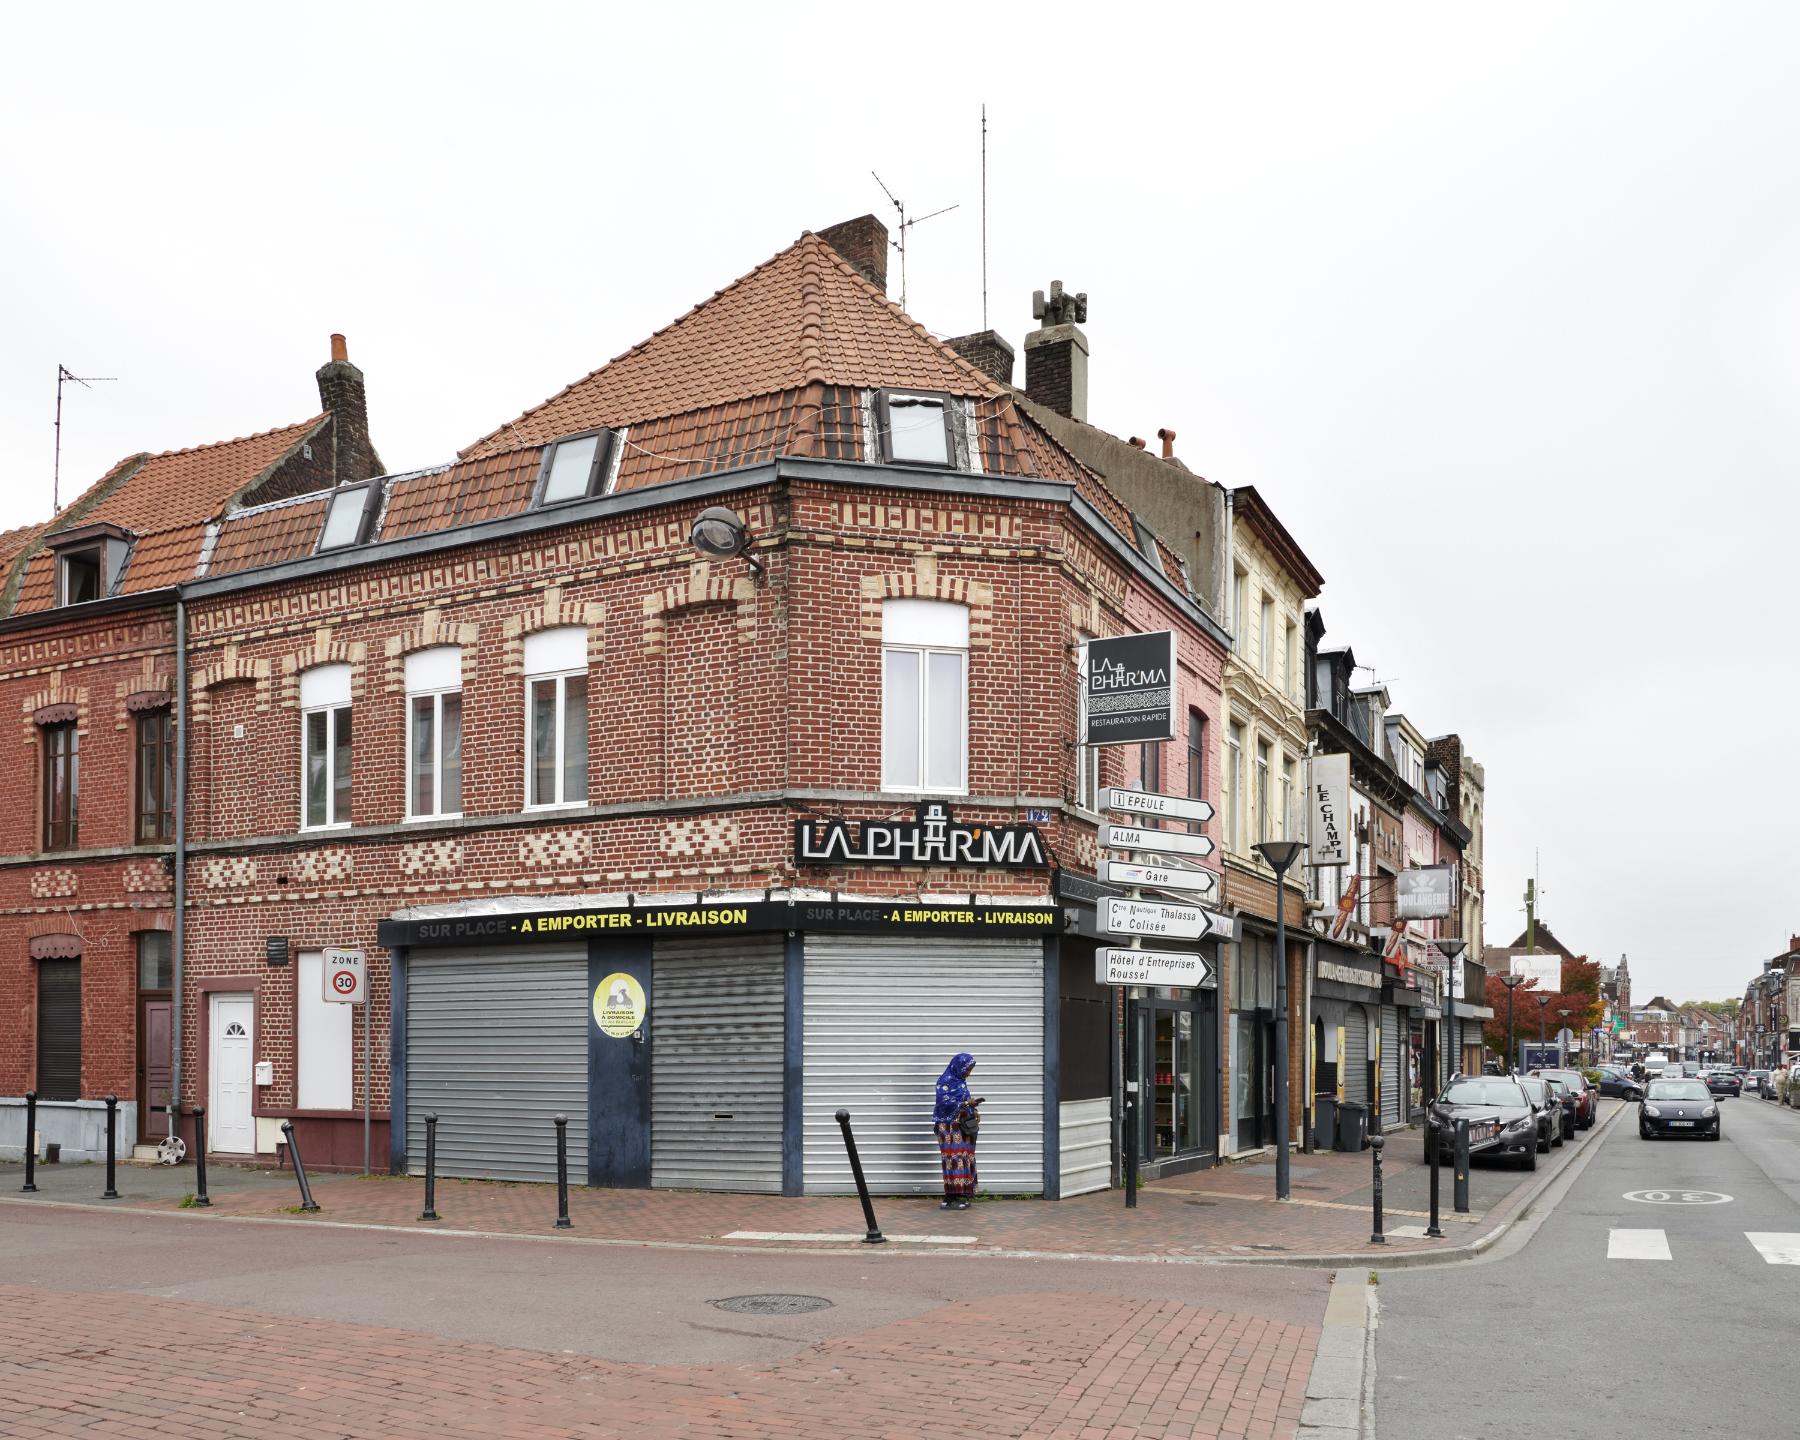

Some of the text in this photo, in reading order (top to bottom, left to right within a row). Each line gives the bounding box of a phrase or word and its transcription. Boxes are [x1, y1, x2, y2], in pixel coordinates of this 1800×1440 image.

[1092, 657, 1112, 673] LA
[1091, 712, 1167, 727] RESTAURATION RAPIDE
[1316, 784, 1329, 801] LE
[1128, 796, 1165, 811] EPEULE
[802, 823, 850, 859] LA
[1112, 831, 1141, 844] ALMA
[1145, 870, 1169, 883] Gare
[806, 908, 834, 920] SUR
[838, 908, 880, 921] PLACE
[891, 910, 901, 922] A
[904, 910, 974, 923] EMPORTER
[985, 912, 1053, 925] LIVRAISON
[1129, 904, 1157, 916] Nautique
[1161, 908, 1197, 921] Thalassa
[419, 922, 451, 939] SUR
[456, 919, 507, 937] PLACE
[521, 919, 533, 933] A
[537, 912, 632, 932] EMPORTER
[646, 909, 748, 927] LIVRAISON
[1111, 918, 1166, 931] Le Colisée
[332, 956, 359, 965] ZONE
[1110, 954, 1196, 970] Hôtel d'Entreprises
[1110, 967, 1149, 980] Roussel
[337, 977, 352, 988] 30
